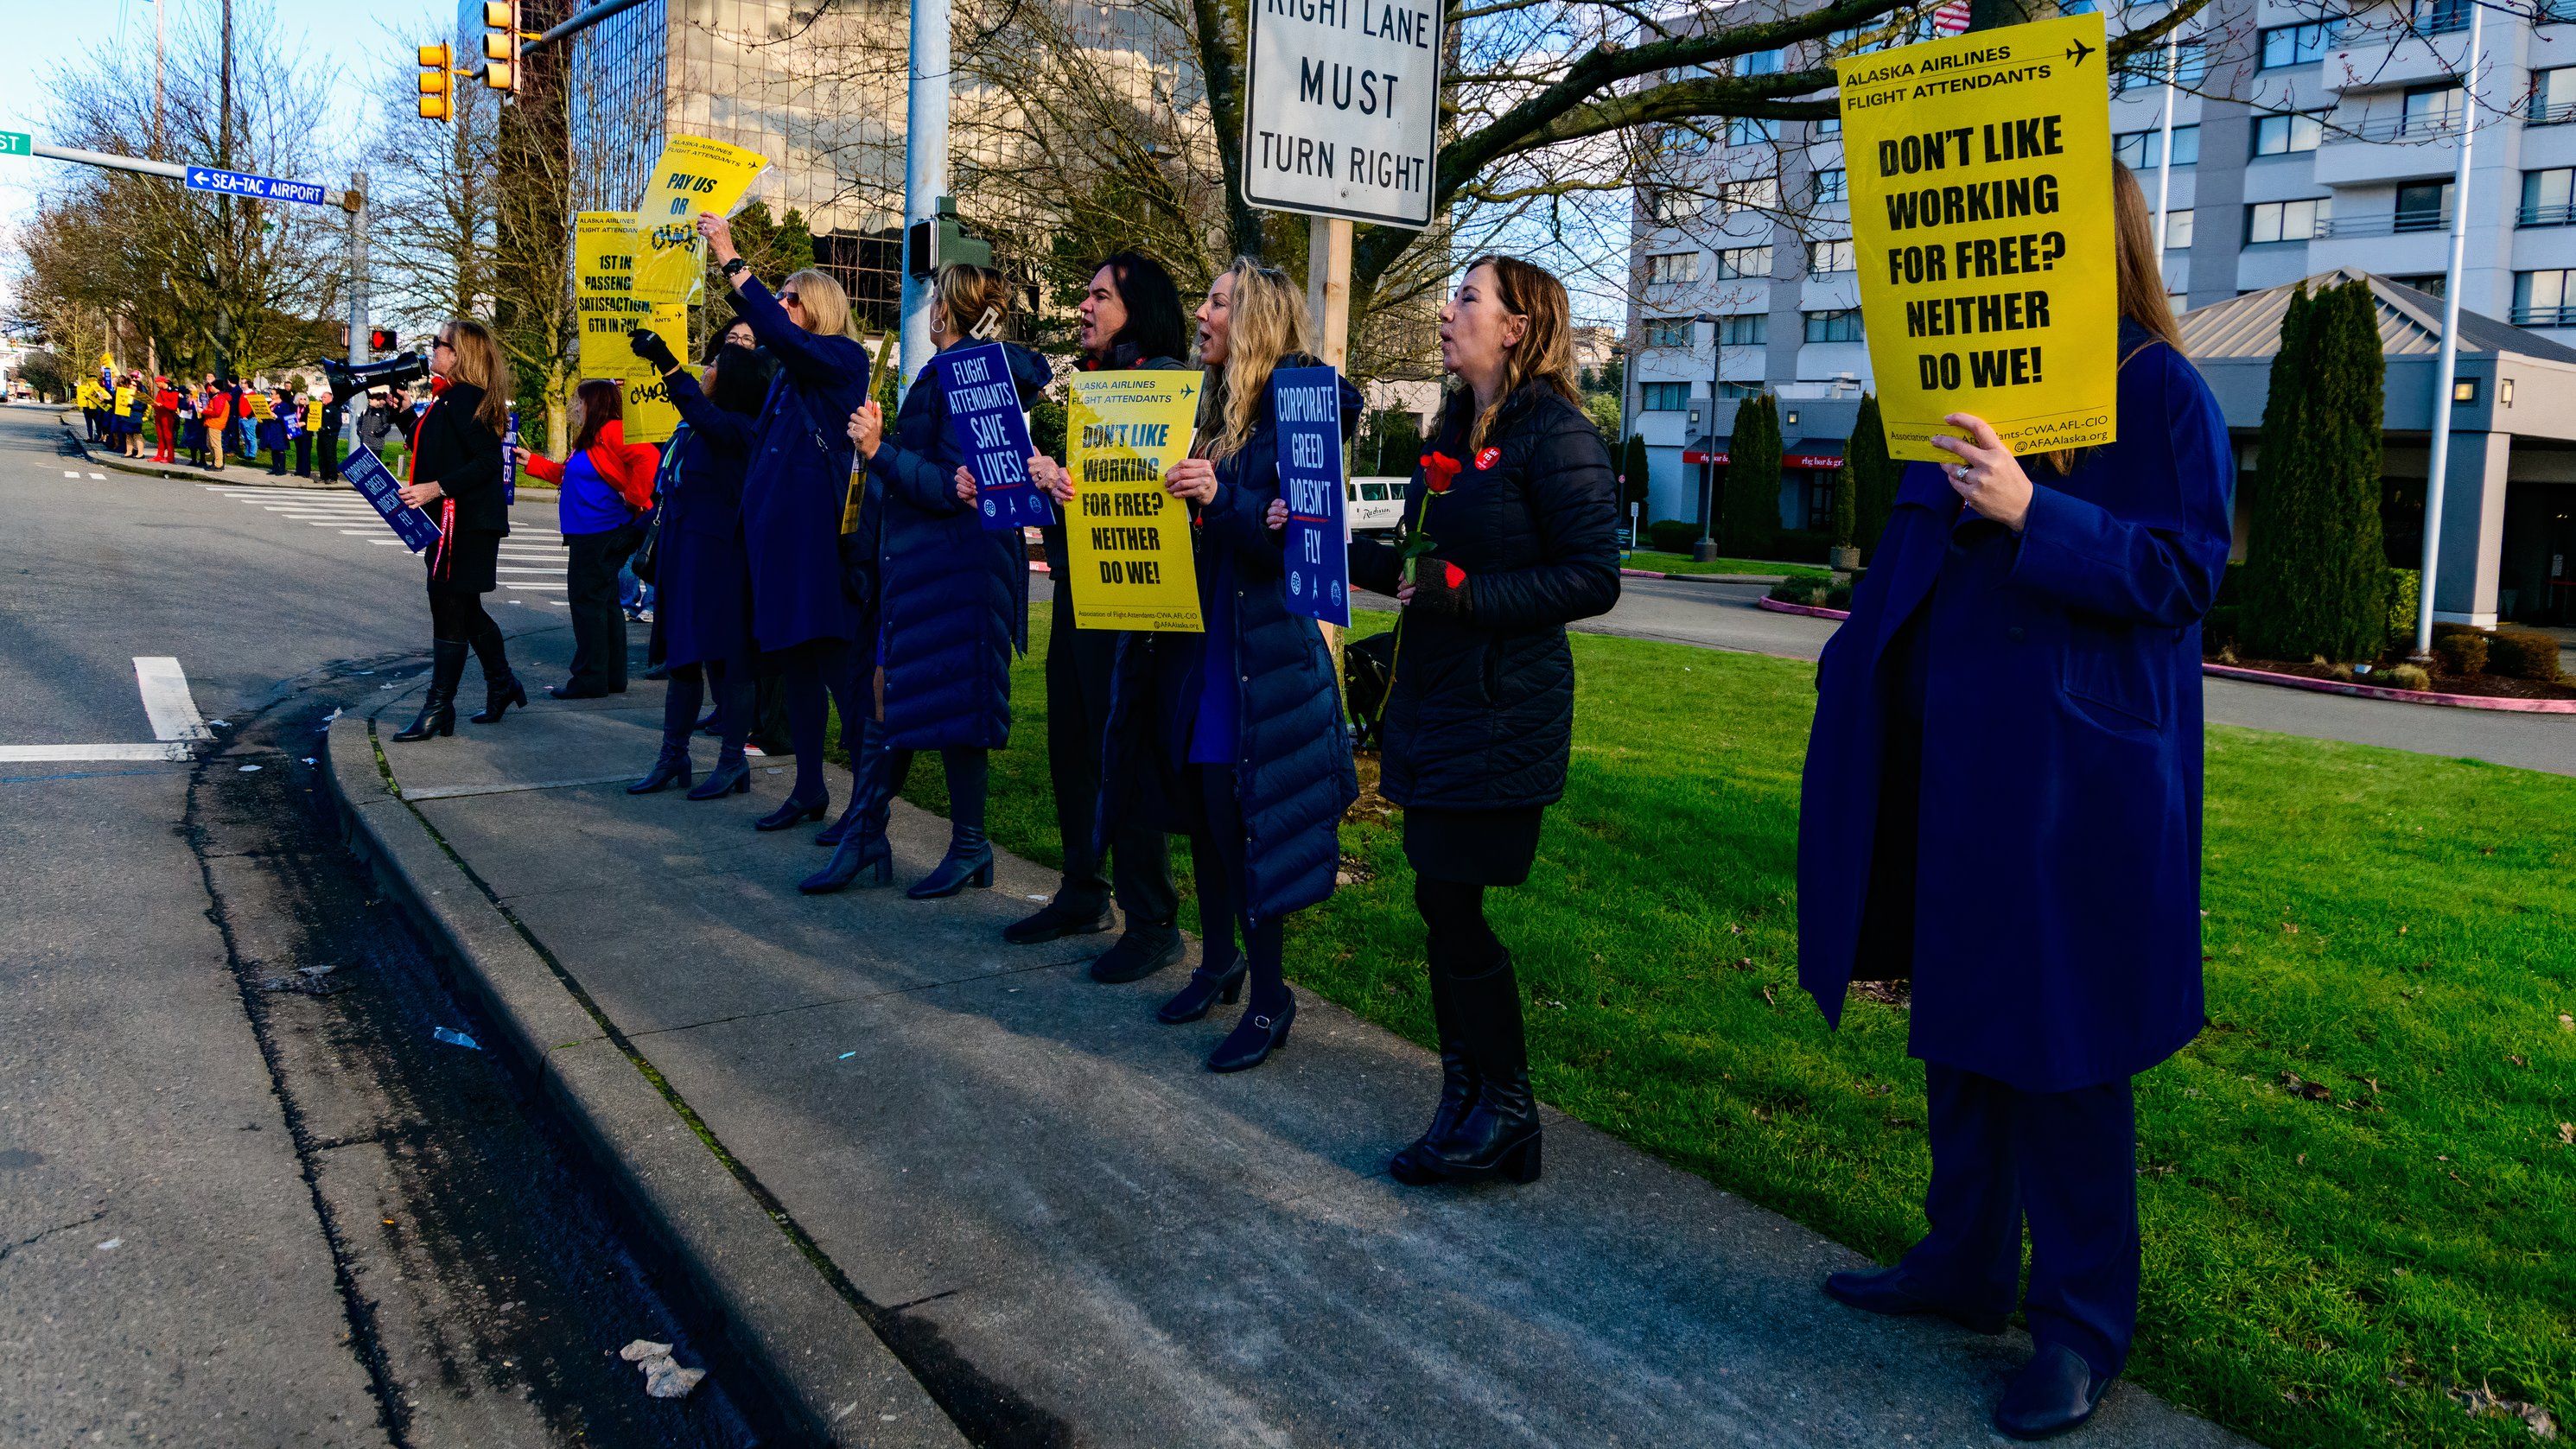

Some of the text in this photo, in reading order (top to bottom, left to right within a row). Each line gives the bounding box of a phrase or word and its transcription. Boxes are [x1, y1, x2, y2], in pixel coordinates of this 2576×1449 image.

[1364, 0, 1428, 49] LANE
[1846, 46, 2011, 87] ALASKA AIRLINES
[1301, 56, 1398, 118] MUST
[1848, 65, 2051, 111] FLIGHT ATTENDANTS
[0, 135, 20, 151] ST
[672, 139, 734, 156] ALASKA AIRLINES
[1879, 114, 2064, 178] DON'T LIKE
[691, 150, 741, 167] ATTENDANTS
[1260, 130, 1424, 193] TURN RIGHT
[212, 173, 321, 201] SEA-TAC AIRPORT
[666, 173, 717, 193] PAY US
[671, 197, 690, 215] OR
[1886, 174, 2059, 231] WORKING
[599, 255, 632, 270] 1ST IN
[1888, 231, 2066, 285] FOR FREE?
[585, 276, 633, 290] PASSENG
[588, 318, 606, 333] 6TH
[609, 318, 619, 333] IN
[1906, 290, 2050, 337] NEITHER
[952, 357, 990, 385] FLIGHT
[1918, 346, 2042, 391] DO WE!
[949, 382, 1014, 415] ATTENDANTS
[1072, 395, 1172, 404] FLIGHT ATTENDANTS
[1073, 382, 1108, 391] ALASKA
[1278, 386, 1335, 422] CORPORATE
[970, 413, 1011, 448] SAVE
[1082, 424, 1170, 448] DON'T LIKE
[1891, 431, 1930, 442] Association
[2059, 415, 2108, 431] AFL-CIO
[1292, 433, 1324, 469] GREED
[344, 452, 379, 484] CORPORATE
[976, 450, 1027, 486] LIVES!
[1083, 457, 1159, 482] WORKING
[365, 473, 387, 496] GREED
[1289, 478, 1331, 516] DOESN'T
[398, 510, 414, 527] FLY
[1082, 492, 1164, 517] FOR FREE?
[1091, 527, 1161, 550] NEITHER
[1304, 528, 1321, 564] FLY
[1099, 561, 1161, 584] DO WE!
